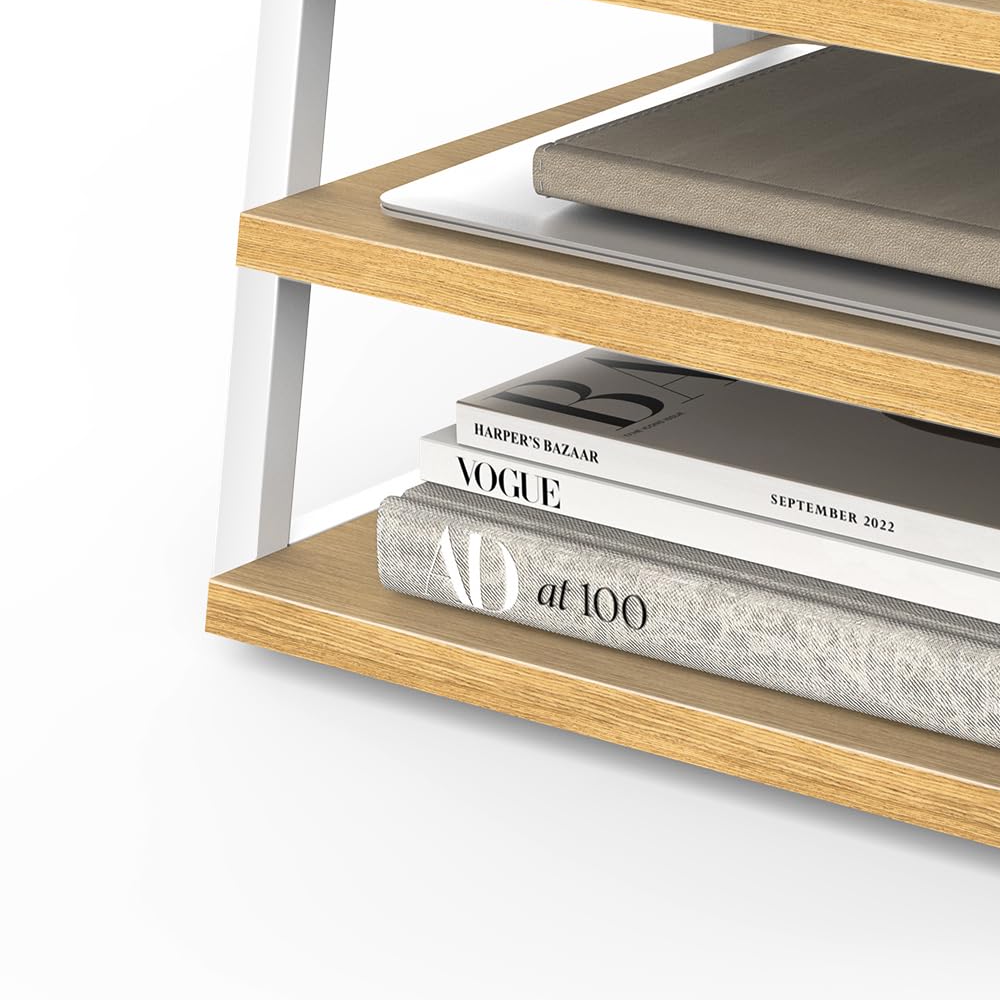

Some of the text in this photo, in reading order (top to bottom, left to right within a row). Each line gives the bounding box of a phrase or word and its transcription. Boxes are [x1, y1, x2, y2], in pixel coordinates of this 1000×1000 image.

[474, 422, 600, 465] HARPER’S BAZAAR
[456, 456, 561, 510] VOGUE
[770, 493, 896, 533] SEPTEMBER 2022
[423, 525, 648, 631] AD at 100
